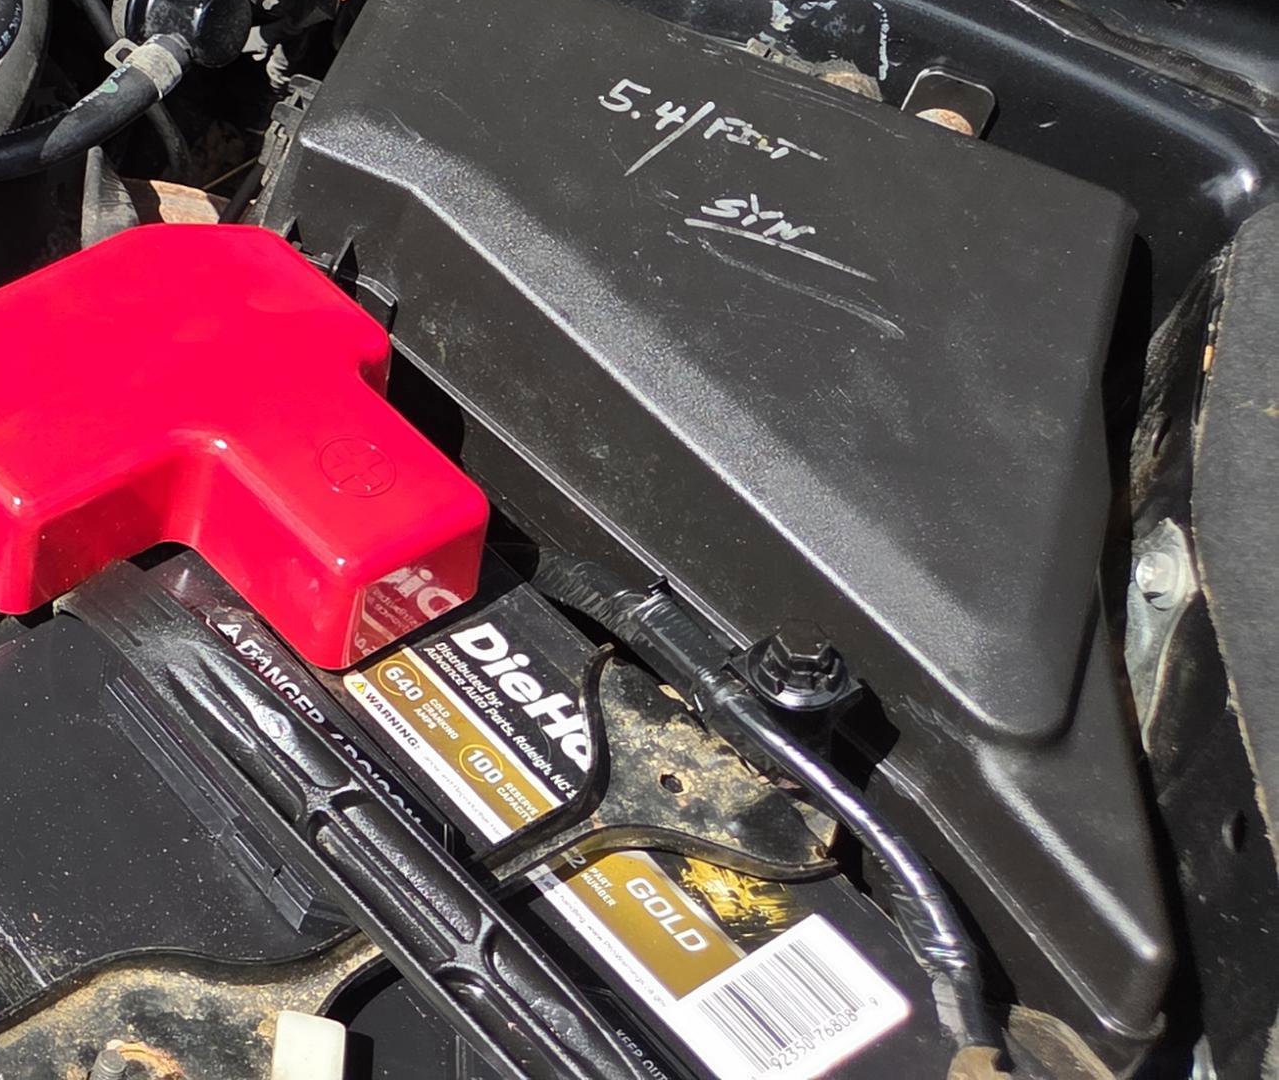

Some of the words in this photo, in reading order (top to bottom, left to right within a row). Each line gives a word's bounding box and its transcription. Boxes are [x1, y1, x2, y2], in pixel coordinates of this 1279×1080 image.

[382, 665, 426, 703] 640
[421, 646, 465, 686] Advance
[459, 681, 489, 710] Auto
[433, 640, 491, 695] Distributed
[427, 697, 451, 720] COLD
[447, 617, 598, 775] DieHa
[362, 693, 423, 752] WARNING:
[411, 706, 437, 730] AMPS
[420, 702, 460, 741] CRANKING
[464, 749, 504, 786] 100
[501, 781, 540, 818] RESERVE
[579, 871, 617, 908] NUMBER
[587, 866, 612, 889] PART
[622, 873, 710, 957] GOLD
[768, 1033, 817, 1071] 92350
[812, 1005, 859, 1038] 76808
